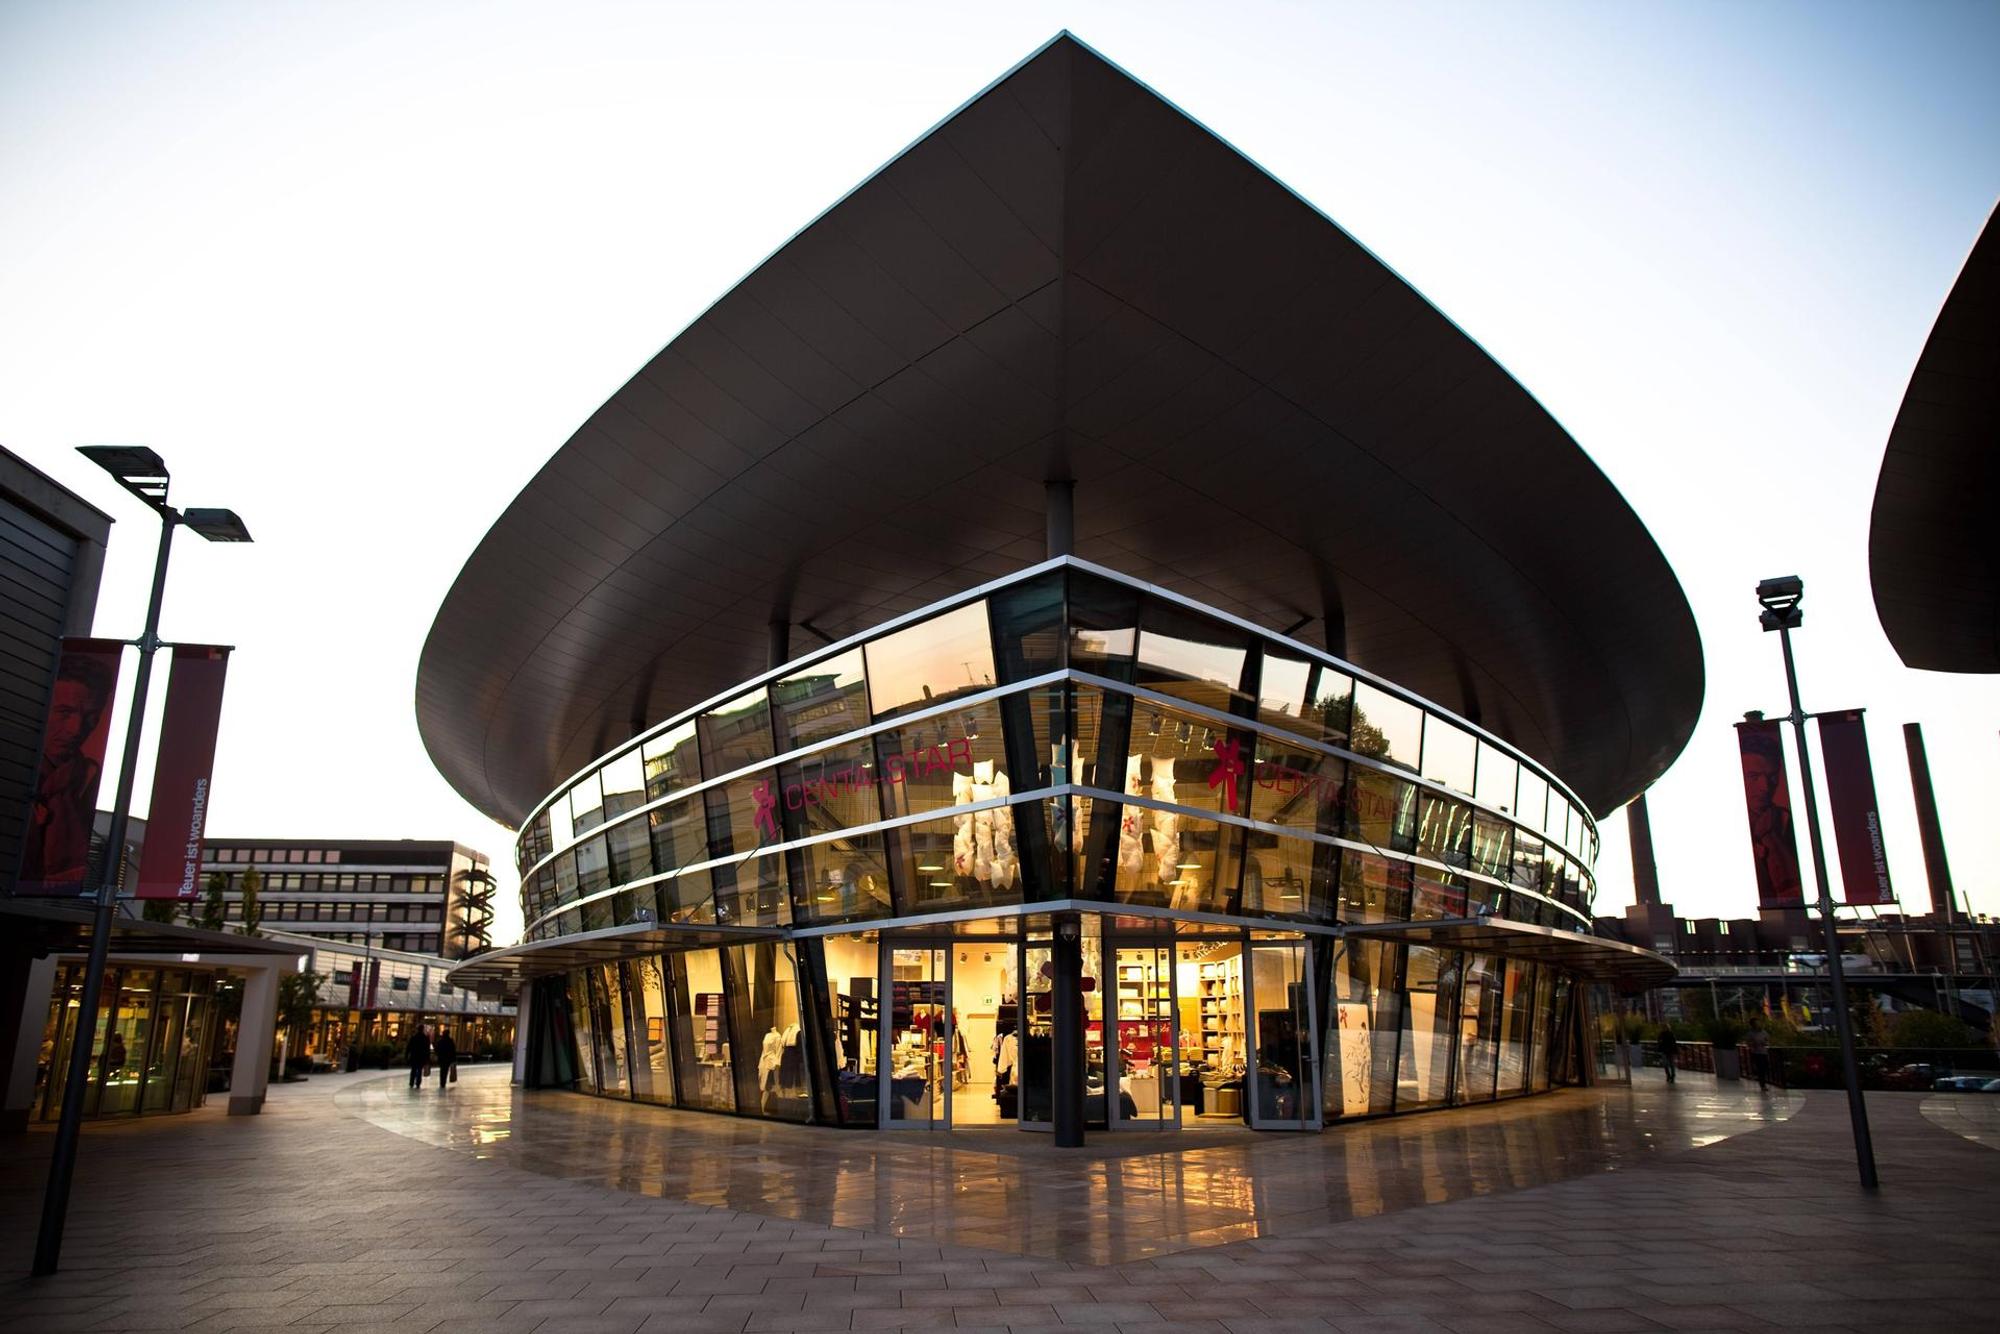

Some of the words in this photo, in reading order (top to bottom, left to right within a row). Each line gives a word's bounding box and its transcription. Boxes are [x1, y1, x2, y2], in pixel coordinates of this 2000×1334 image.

[785, 738, 973, 811] CENTA-STAR
[190, 778, 208, 841] woanders
[184, 842, 199, 859] ist
[1866, 810, 1884, 860] woanders
[178, 861, 196, 897] Teuer
[1873, 860, 1886, 874] ist
[1878, 876, 1892, 903] Teuer
